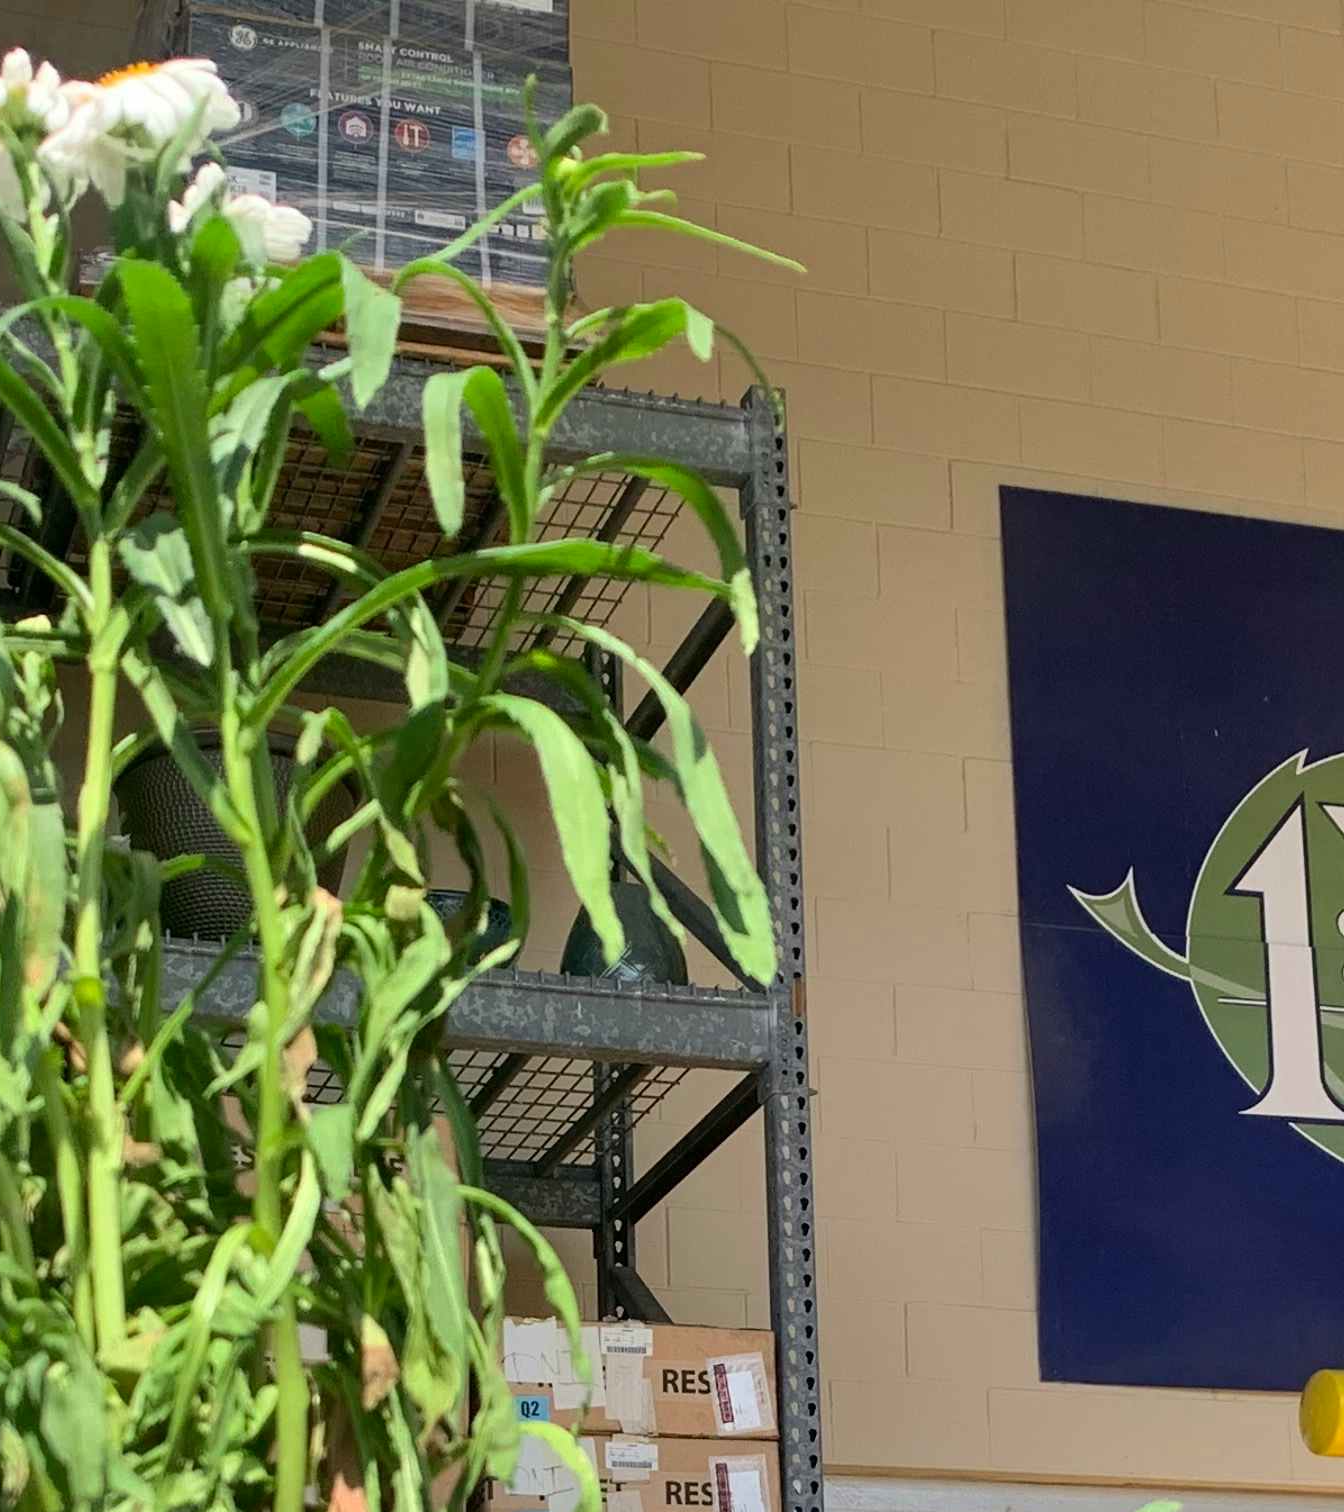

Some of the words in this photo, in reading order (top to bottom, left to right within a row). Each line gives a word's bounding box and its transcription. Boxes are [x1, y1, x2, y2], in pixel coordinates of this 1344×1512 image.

[358, 41, 397, 53] SMAT
[309, 88, 373, 106] FATURES
[404, 101, 443, 117] WANT
[520, 1401, 541, 1418] Q2
